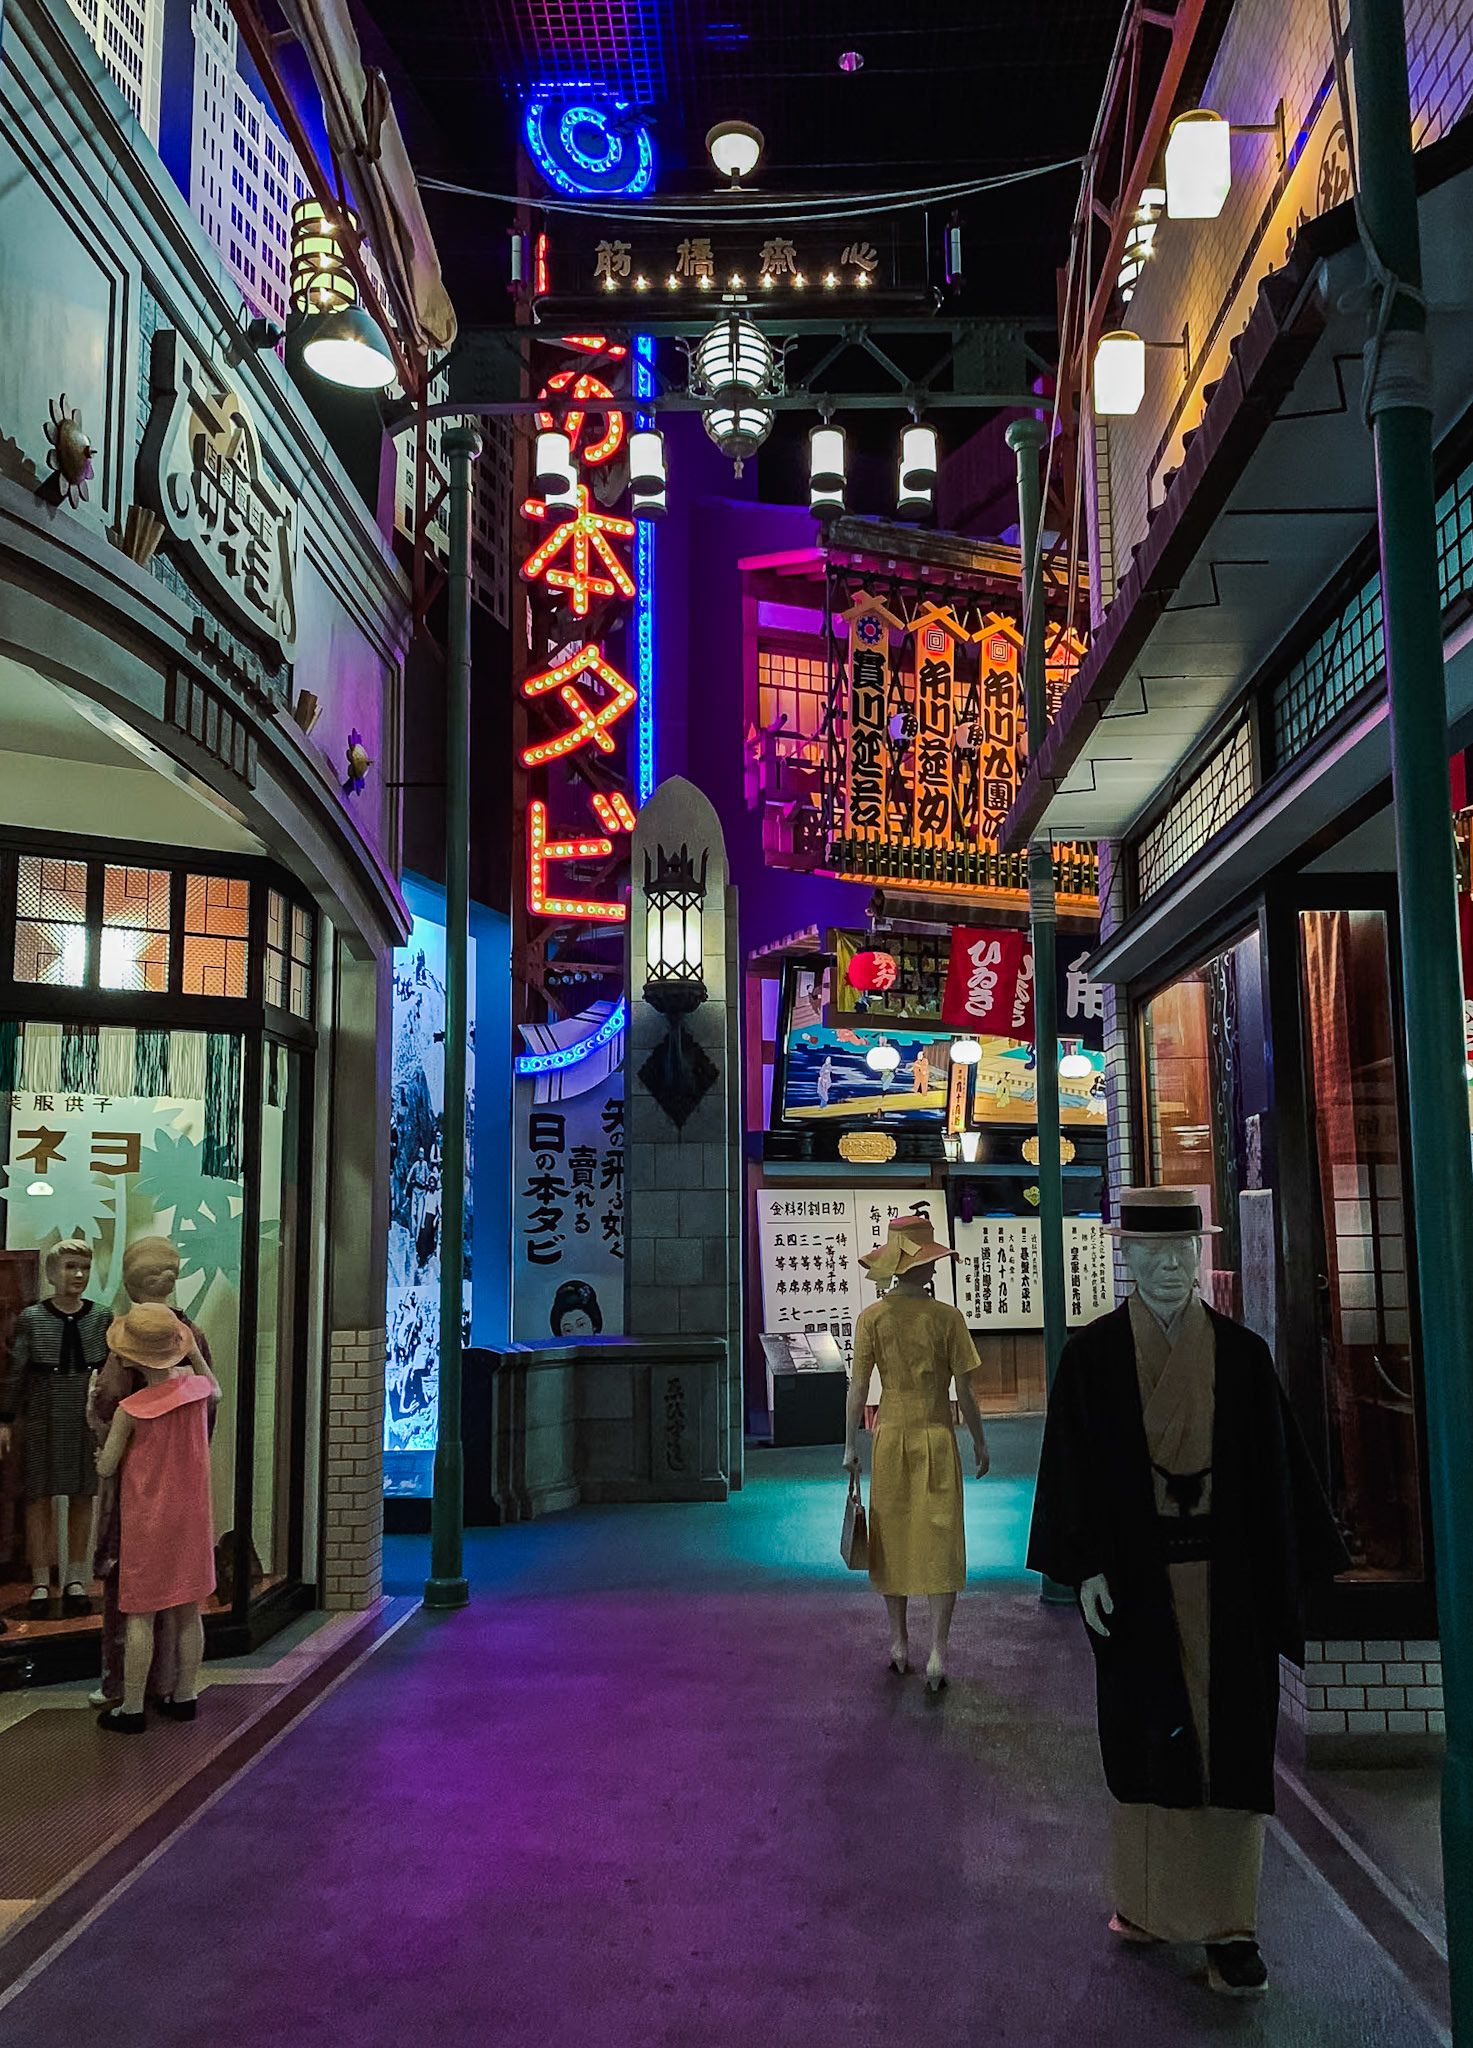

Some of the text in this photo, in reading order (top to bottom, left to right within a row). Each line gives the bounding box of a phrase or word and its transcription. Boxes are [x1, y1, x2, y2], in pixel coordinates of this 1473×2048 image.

[521, 1113, 572, 1265] 日の本タビ
